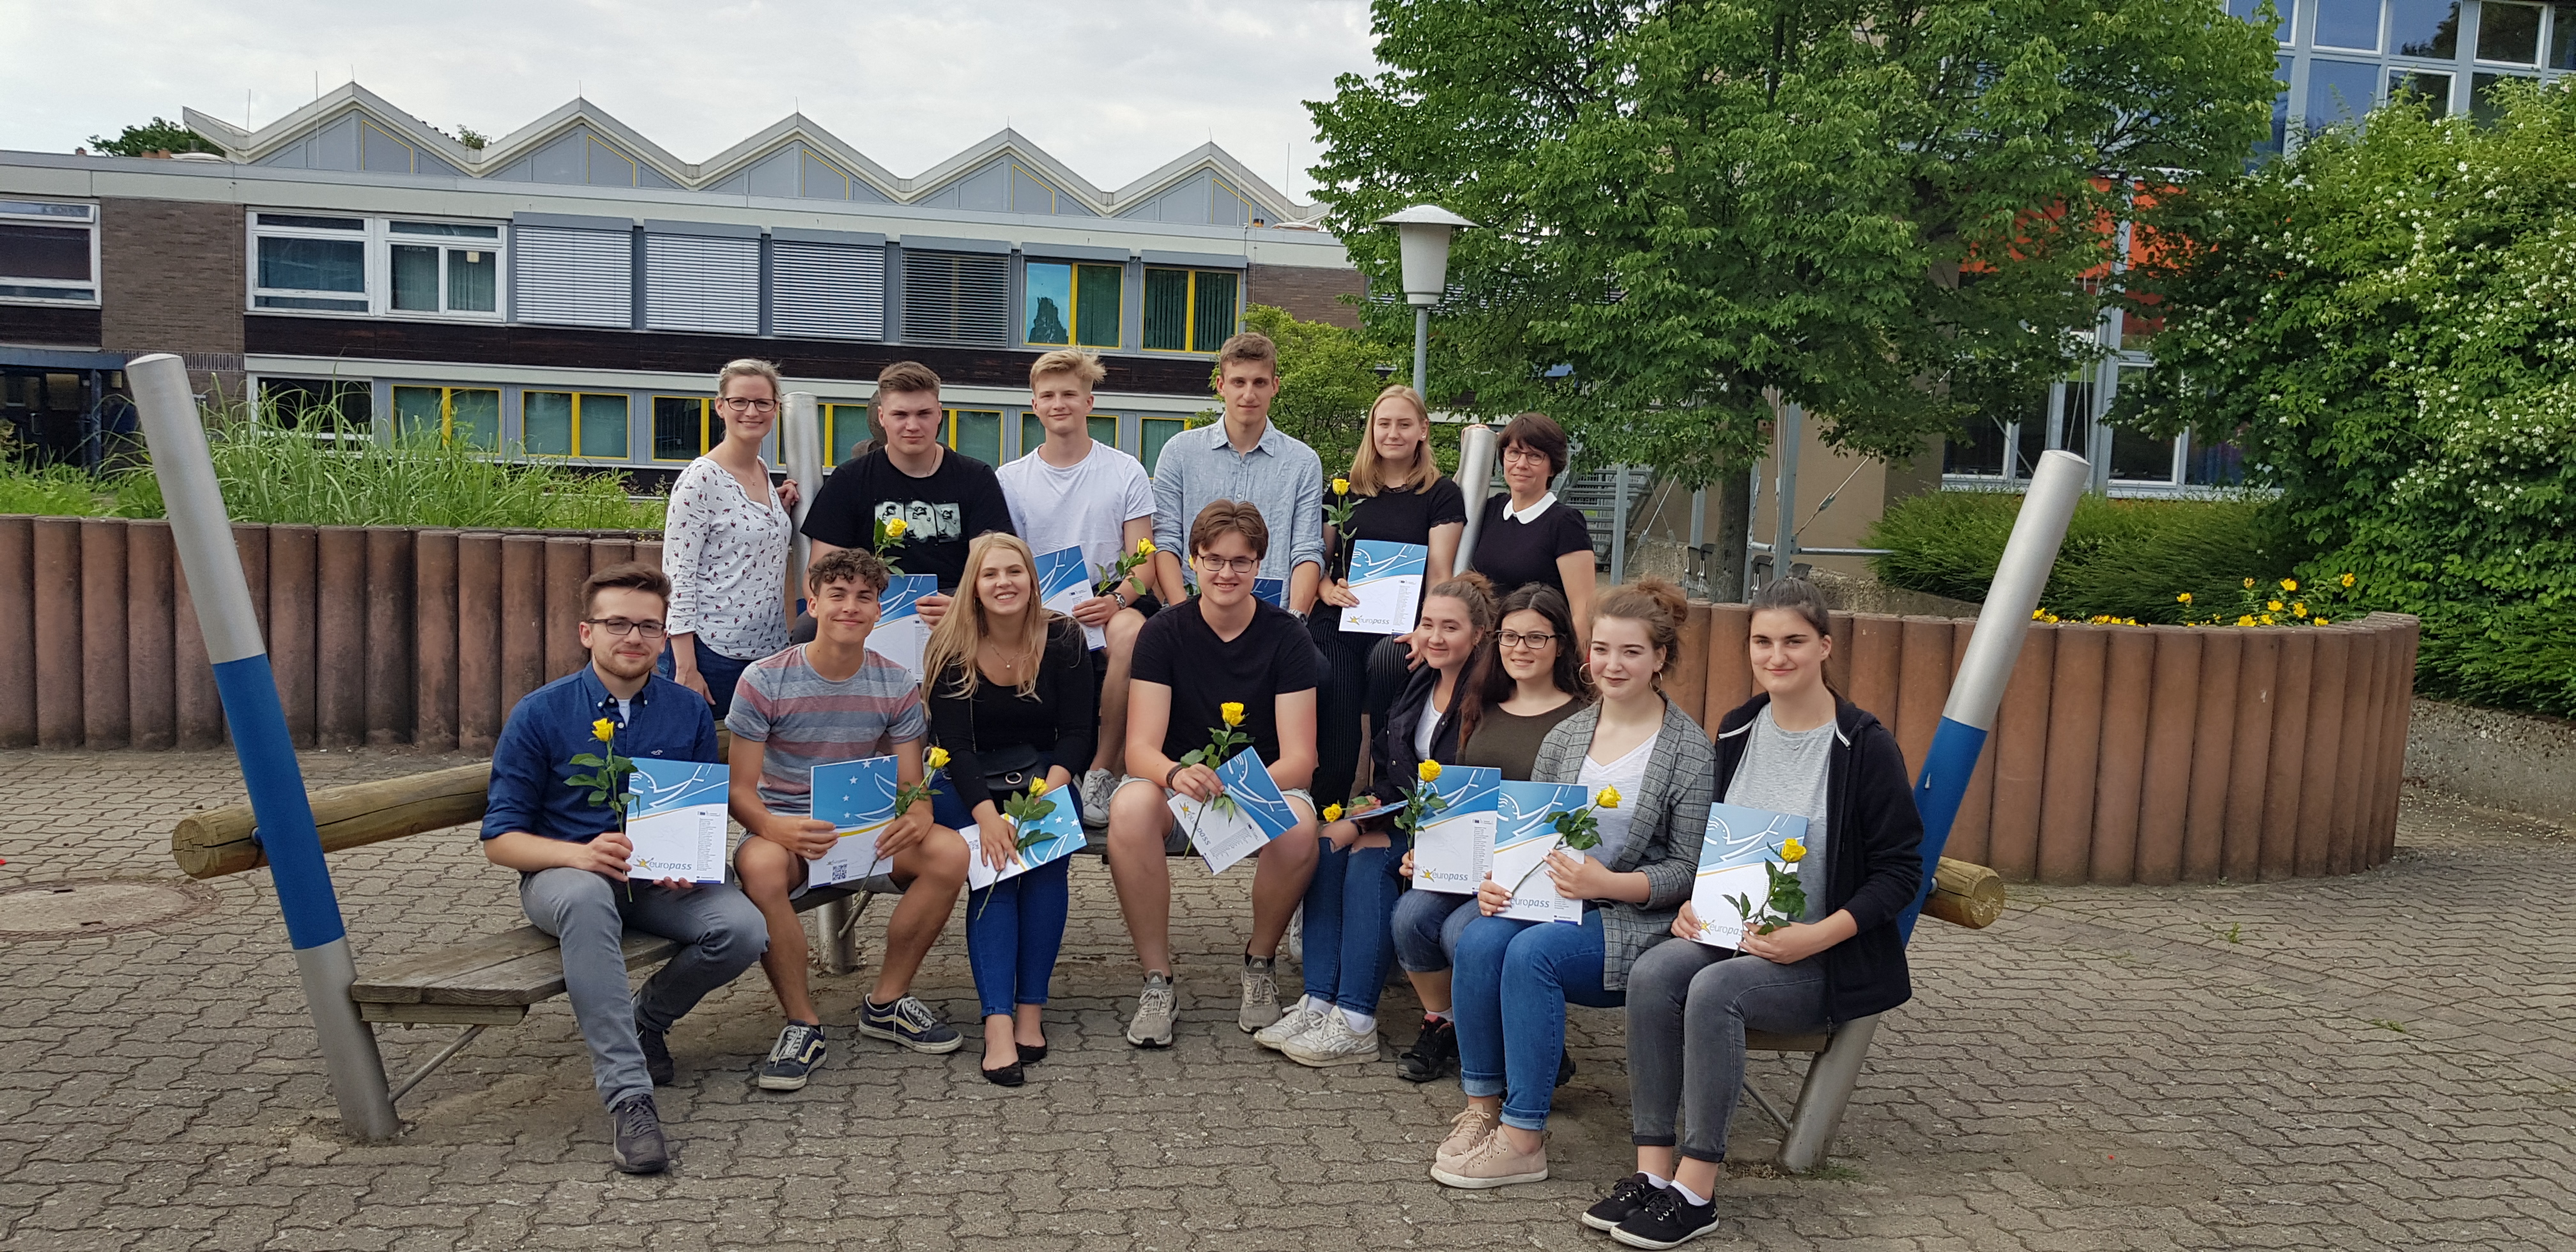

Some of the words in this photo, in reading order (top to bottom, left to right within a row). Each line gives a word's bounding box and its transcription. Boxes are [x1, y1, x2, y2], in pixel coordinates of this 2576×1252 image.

[1188, 813, 1211, 845] eupass
[649, 861, 692, 871] europass
[1432, 871, 1468, 881] europass
[1510, 897, 1550, 908] europass
